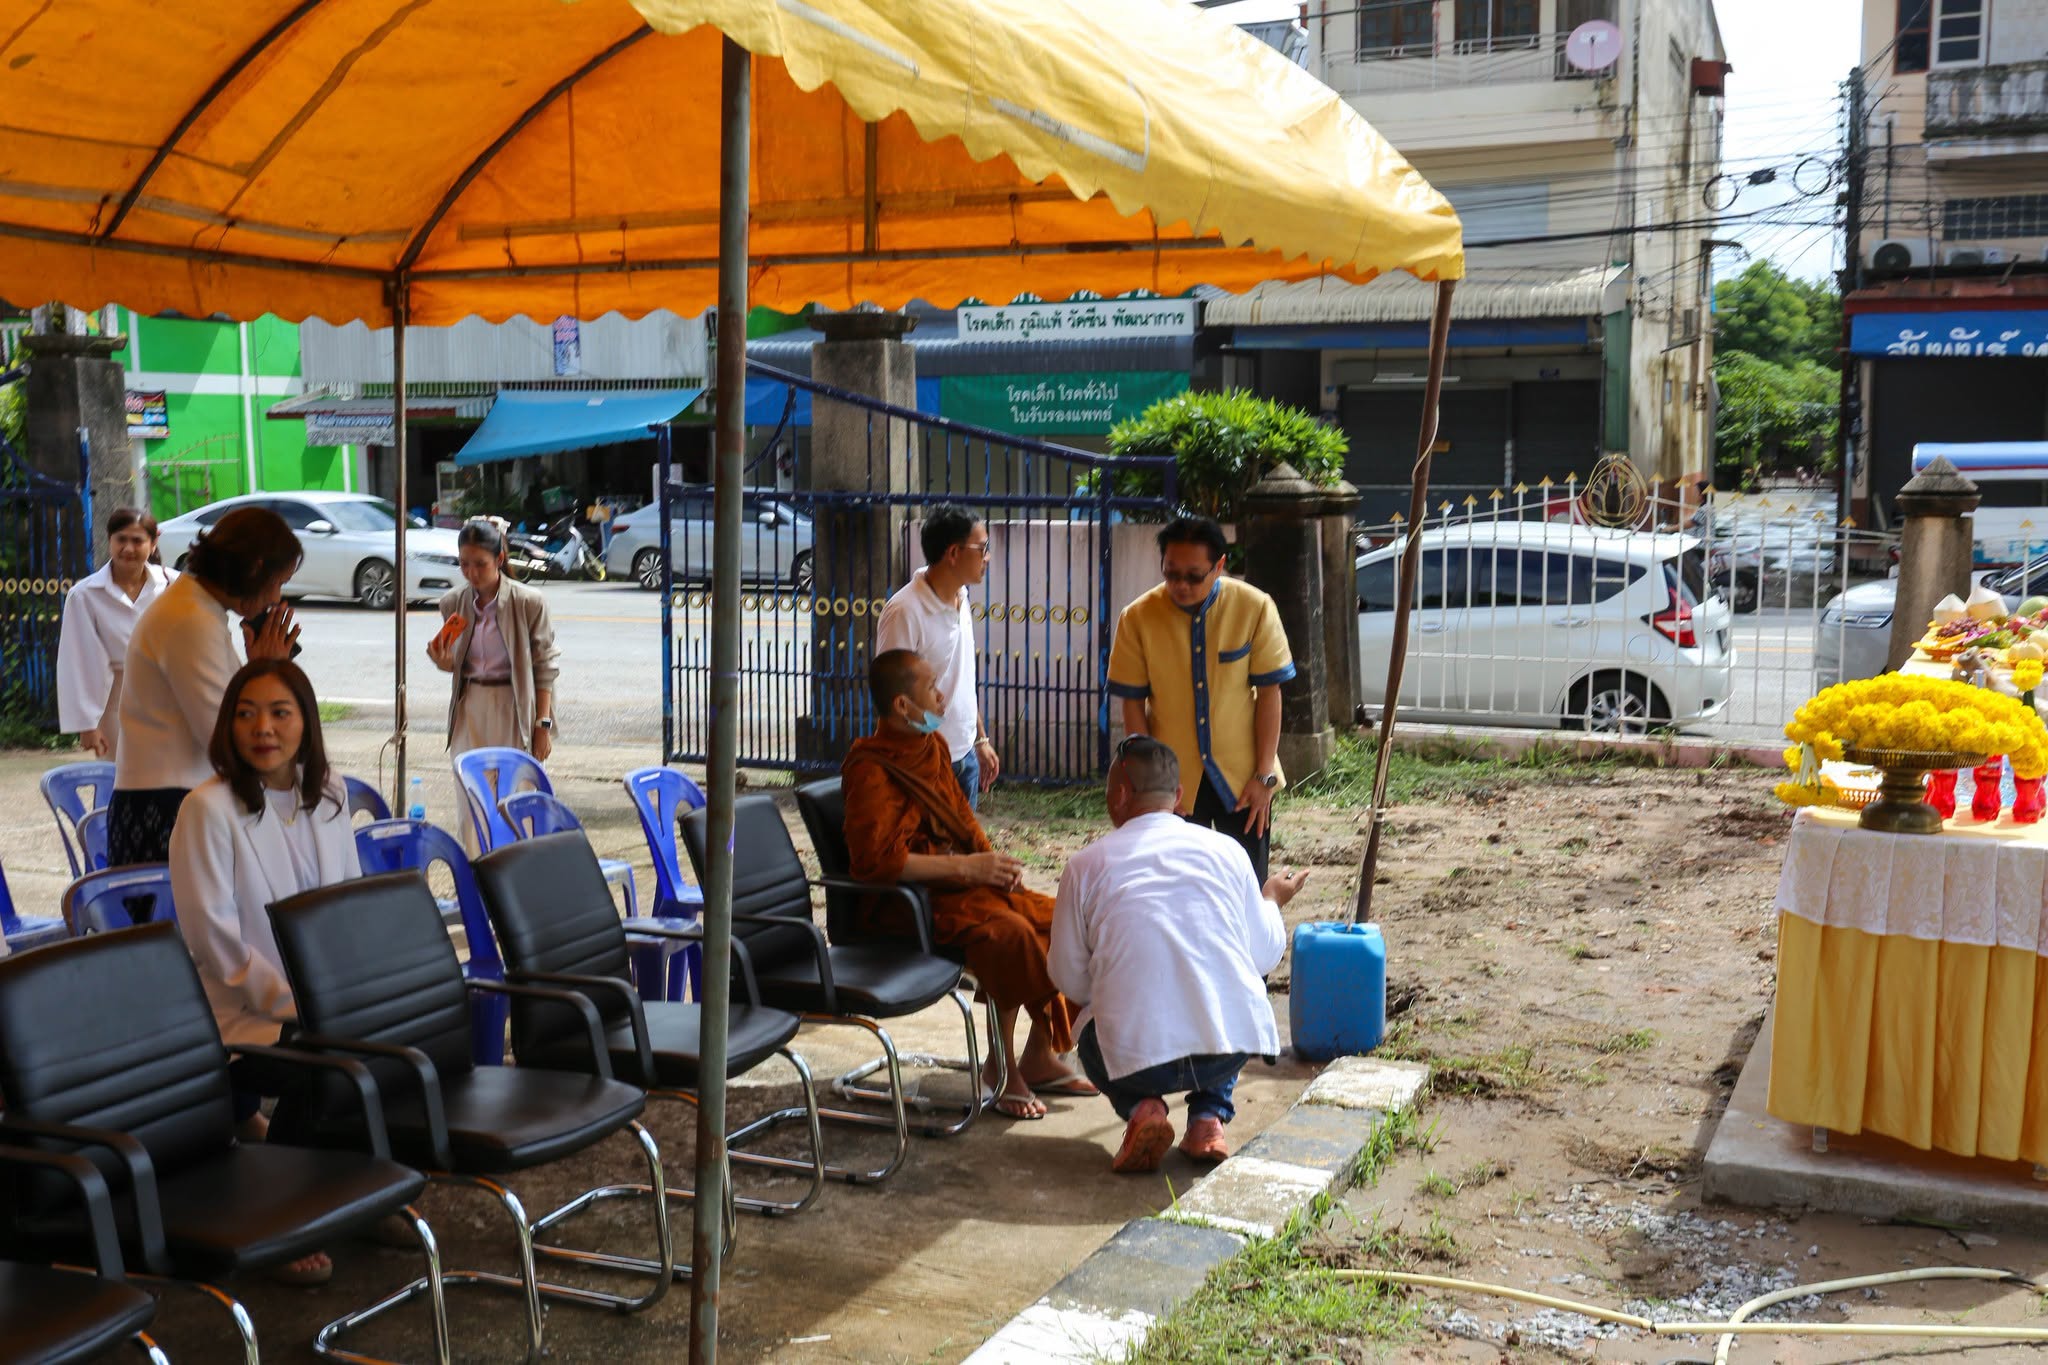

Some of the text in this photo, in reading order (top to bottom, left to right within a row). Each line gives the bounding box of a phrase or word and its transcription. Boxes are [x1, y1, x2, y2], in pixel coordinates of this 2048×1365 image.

[964, 306, 1185, 338] โรคเด็ก ภูมิแพ้ วัคซีน พัฒนาการ
[1006, 379, 1119, 402] โรคเด็ก โรคทั่วไป
[1010, 403, 1114, 423] ใบรับรองแพทย์
